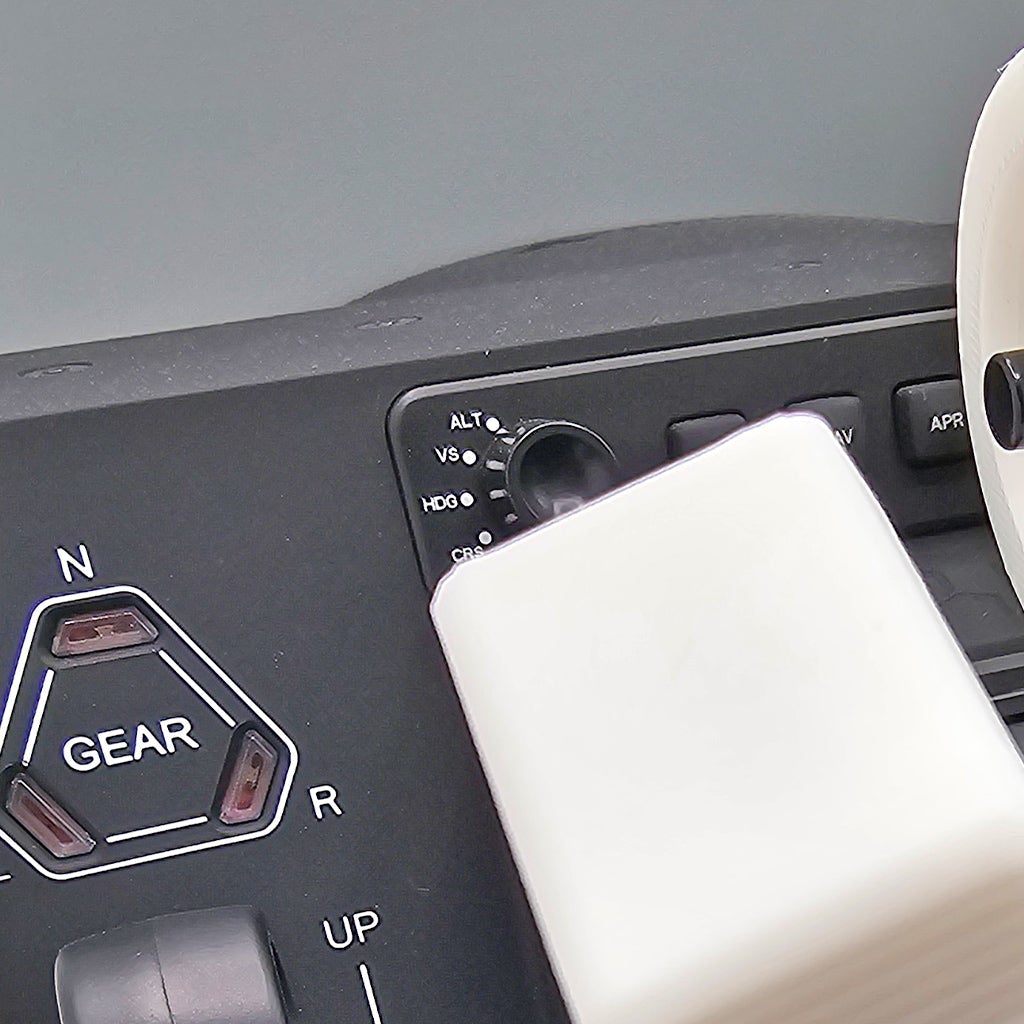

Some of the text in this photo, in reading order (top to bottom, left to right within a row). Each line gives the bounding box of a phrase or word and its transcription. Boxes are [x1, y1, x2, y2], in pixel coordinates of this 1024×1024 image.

[450, 411, 483, 431] ALT
[929, 411, 965, 433] APR
[434, 446, 460, 463] VS
[421, 493, 459, 513] HDG
[56, 543, 95, 583] N
[451, 545, 484, 563] CRS
[62, 716, 200, 772] GEAR
[309, 784, 344, 820] R
[322, 910, 381, 950] UP
